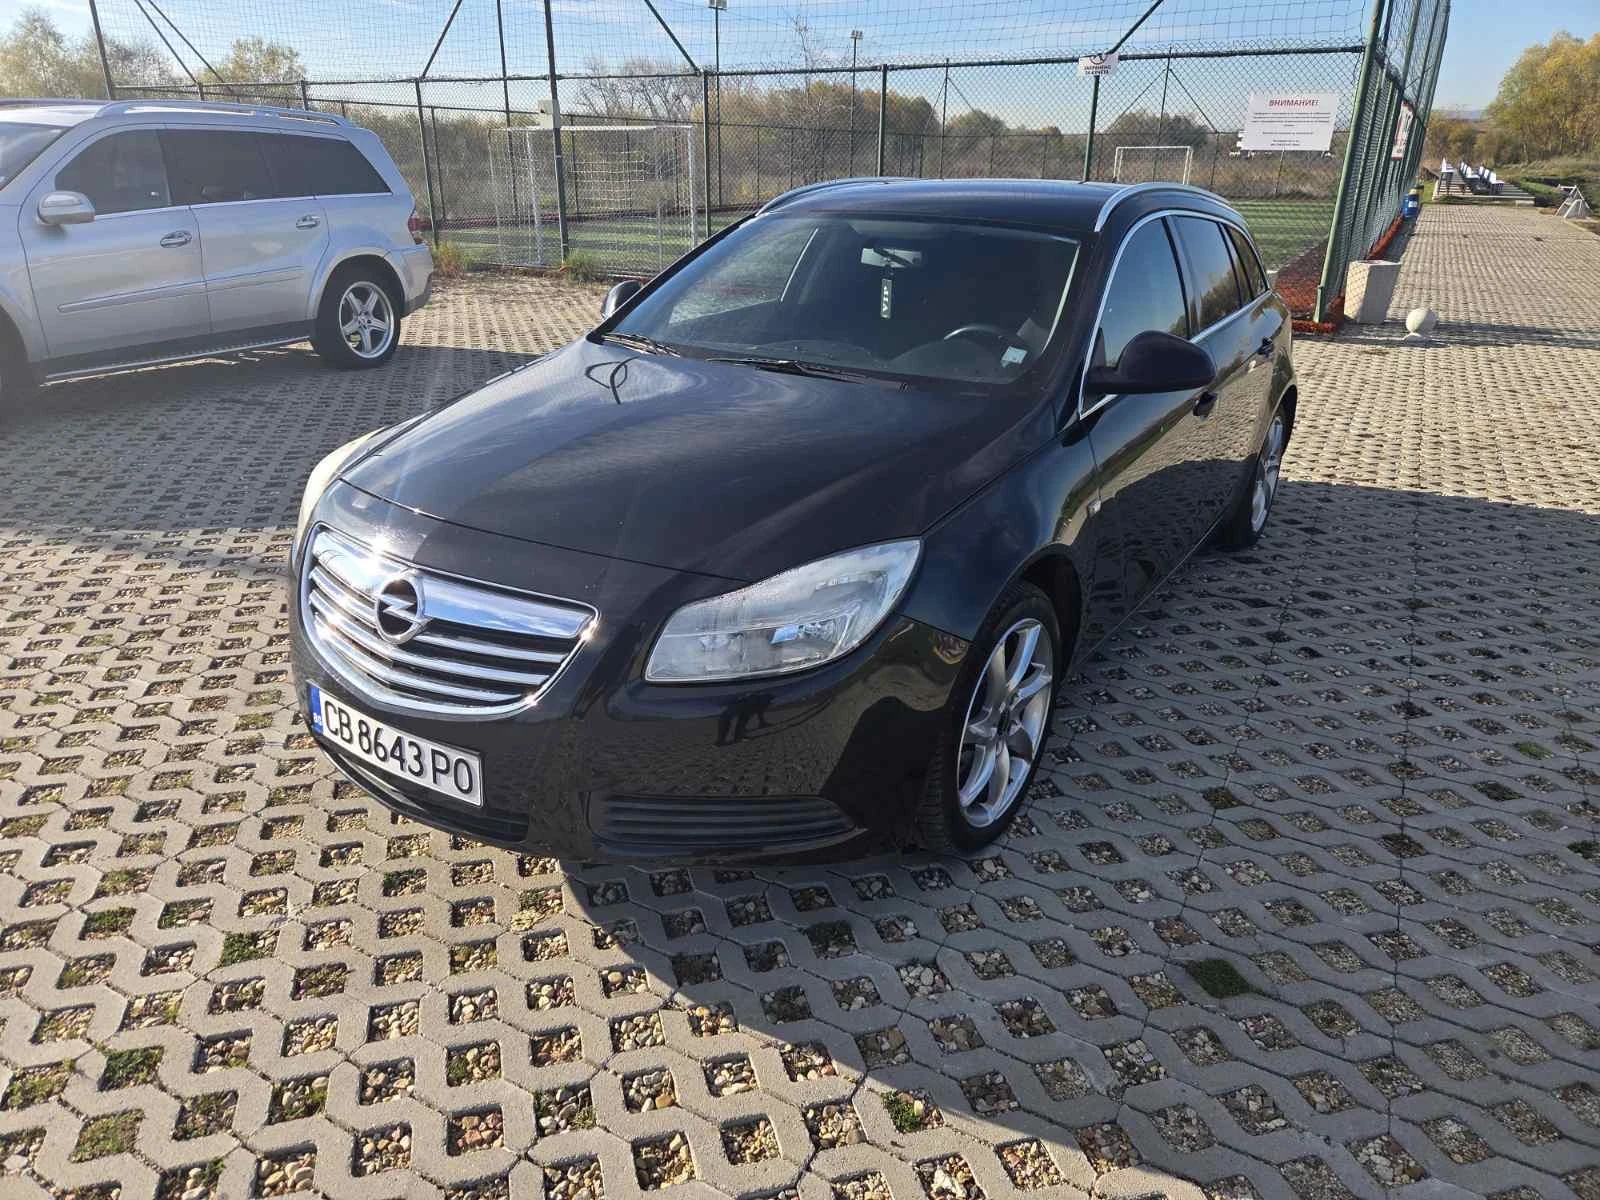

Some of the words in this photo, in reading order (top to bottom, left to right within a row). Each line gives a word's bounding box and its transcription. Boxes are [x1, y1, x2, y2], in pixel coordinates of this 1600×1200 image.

[1269, 99, 1319, 107] ВНИМАНИЕ!
[324, 700, 353, 744] CB
[358, 719, 424, 777] 8643
[430, 748, 473, 795] PO
